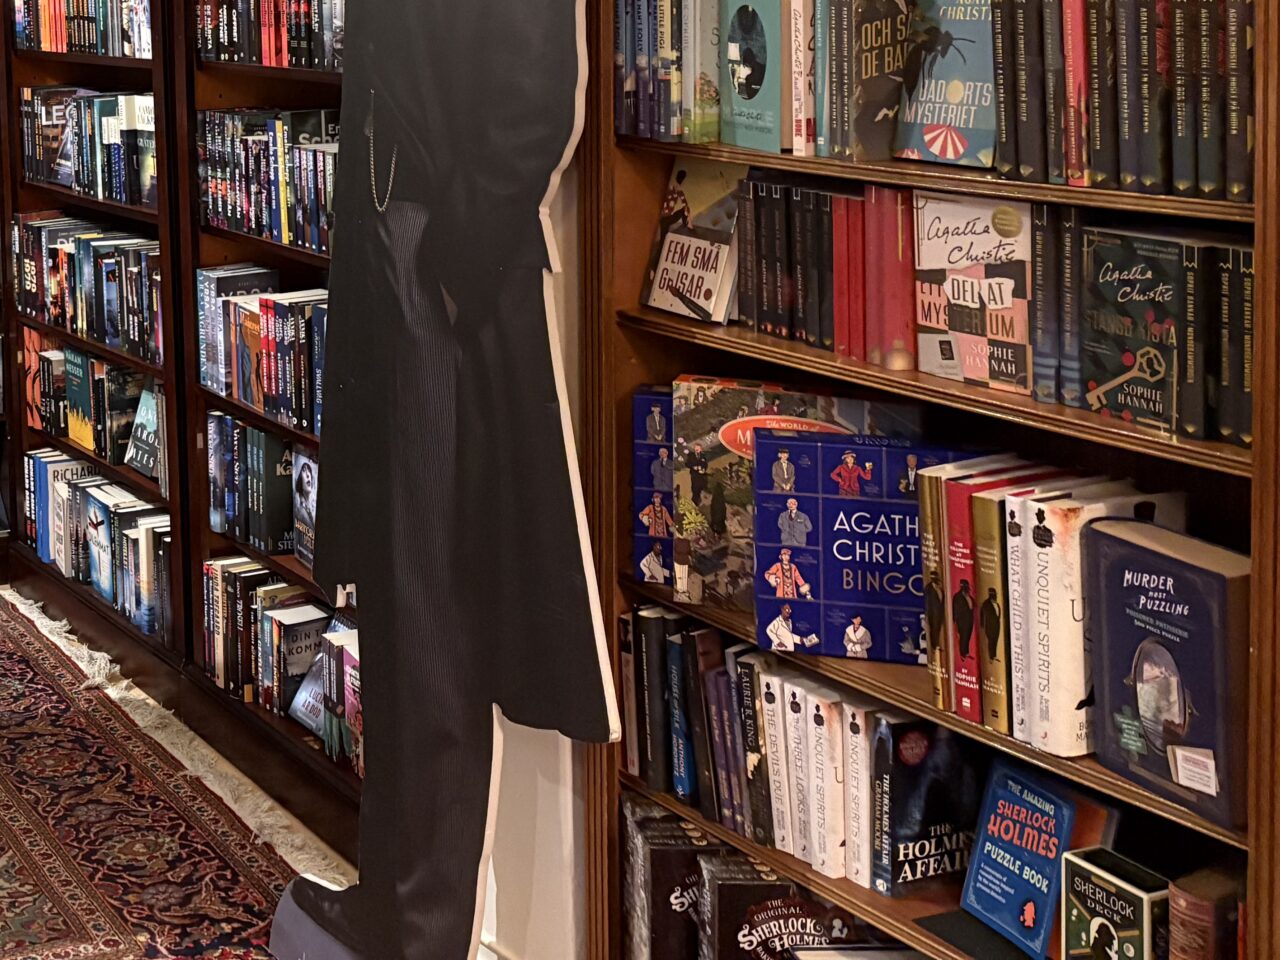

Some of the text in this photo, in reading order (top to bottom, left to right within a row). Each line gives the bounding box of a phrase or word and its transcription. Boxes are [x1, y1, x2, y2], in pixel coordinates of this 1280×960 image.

[862, 18, 891, 50] OCH
[861, 52, 882, 81] DE
[903, 100, 977, 129] MYSTERIET
[927, 216, 991, 248] Agatha
[665, 239, 720, 275] FEM SMÅ
[947, 239, 1017, 265] Christie
[1099, 261, 1153, 284] Agatha
[1117, 282, 1174, 304] Christie
[965, 355, 1016, 375] HANNAH
[971, 343, 1015, 361] SOPHIE
[1117, 392, 1164, 415] HANNAH
[1123, 383, 1163, 402] SOPHIE
[780, 420, 810, 431] WORLD
[832, 511, 919, 534] AGATH
[1010, 544, 1023, 632] WHAT CHILD
[1123, 569, 1175, 596] MURDER
[1148, 591, 1167, 600] most
[1139, 594, 1190, 617] PUZZLING
[1034, 551, 1050, 693] UNQUIET SPIRITS
[741, 668, 756, 747] LAURIE KING
[766, 708, 783, 806] THE DUE
[793, 734, 804, 776] THREE
[850, 732, 860, 790] UNQUIET
[814, 725, 827, 830] UNQUIET SPIRITS
[882, 790, 890, 829] HOLMES
[1007, 780, 1056, 816] THE AMAZING
[997, 799, 1057, 833] SHERLOCK
[881, 830, 889, 865] AFFAIR
[987, 813, 1060, 861] HOLMES
[983, 841, 1021, 876] PUZZLE
[1022, 864, 1050, 894] BOOK
[767, 898, 784, 908] THE
[1073, 875, 1136, 921] SHERLOCK
[1086, 899, 1123, 924] DECK
[753, 905, 803, 922] ORIGINAL
[738, 916, 824, 951] SHERLOCK
[768, 928, 829, 953] HOLMES
